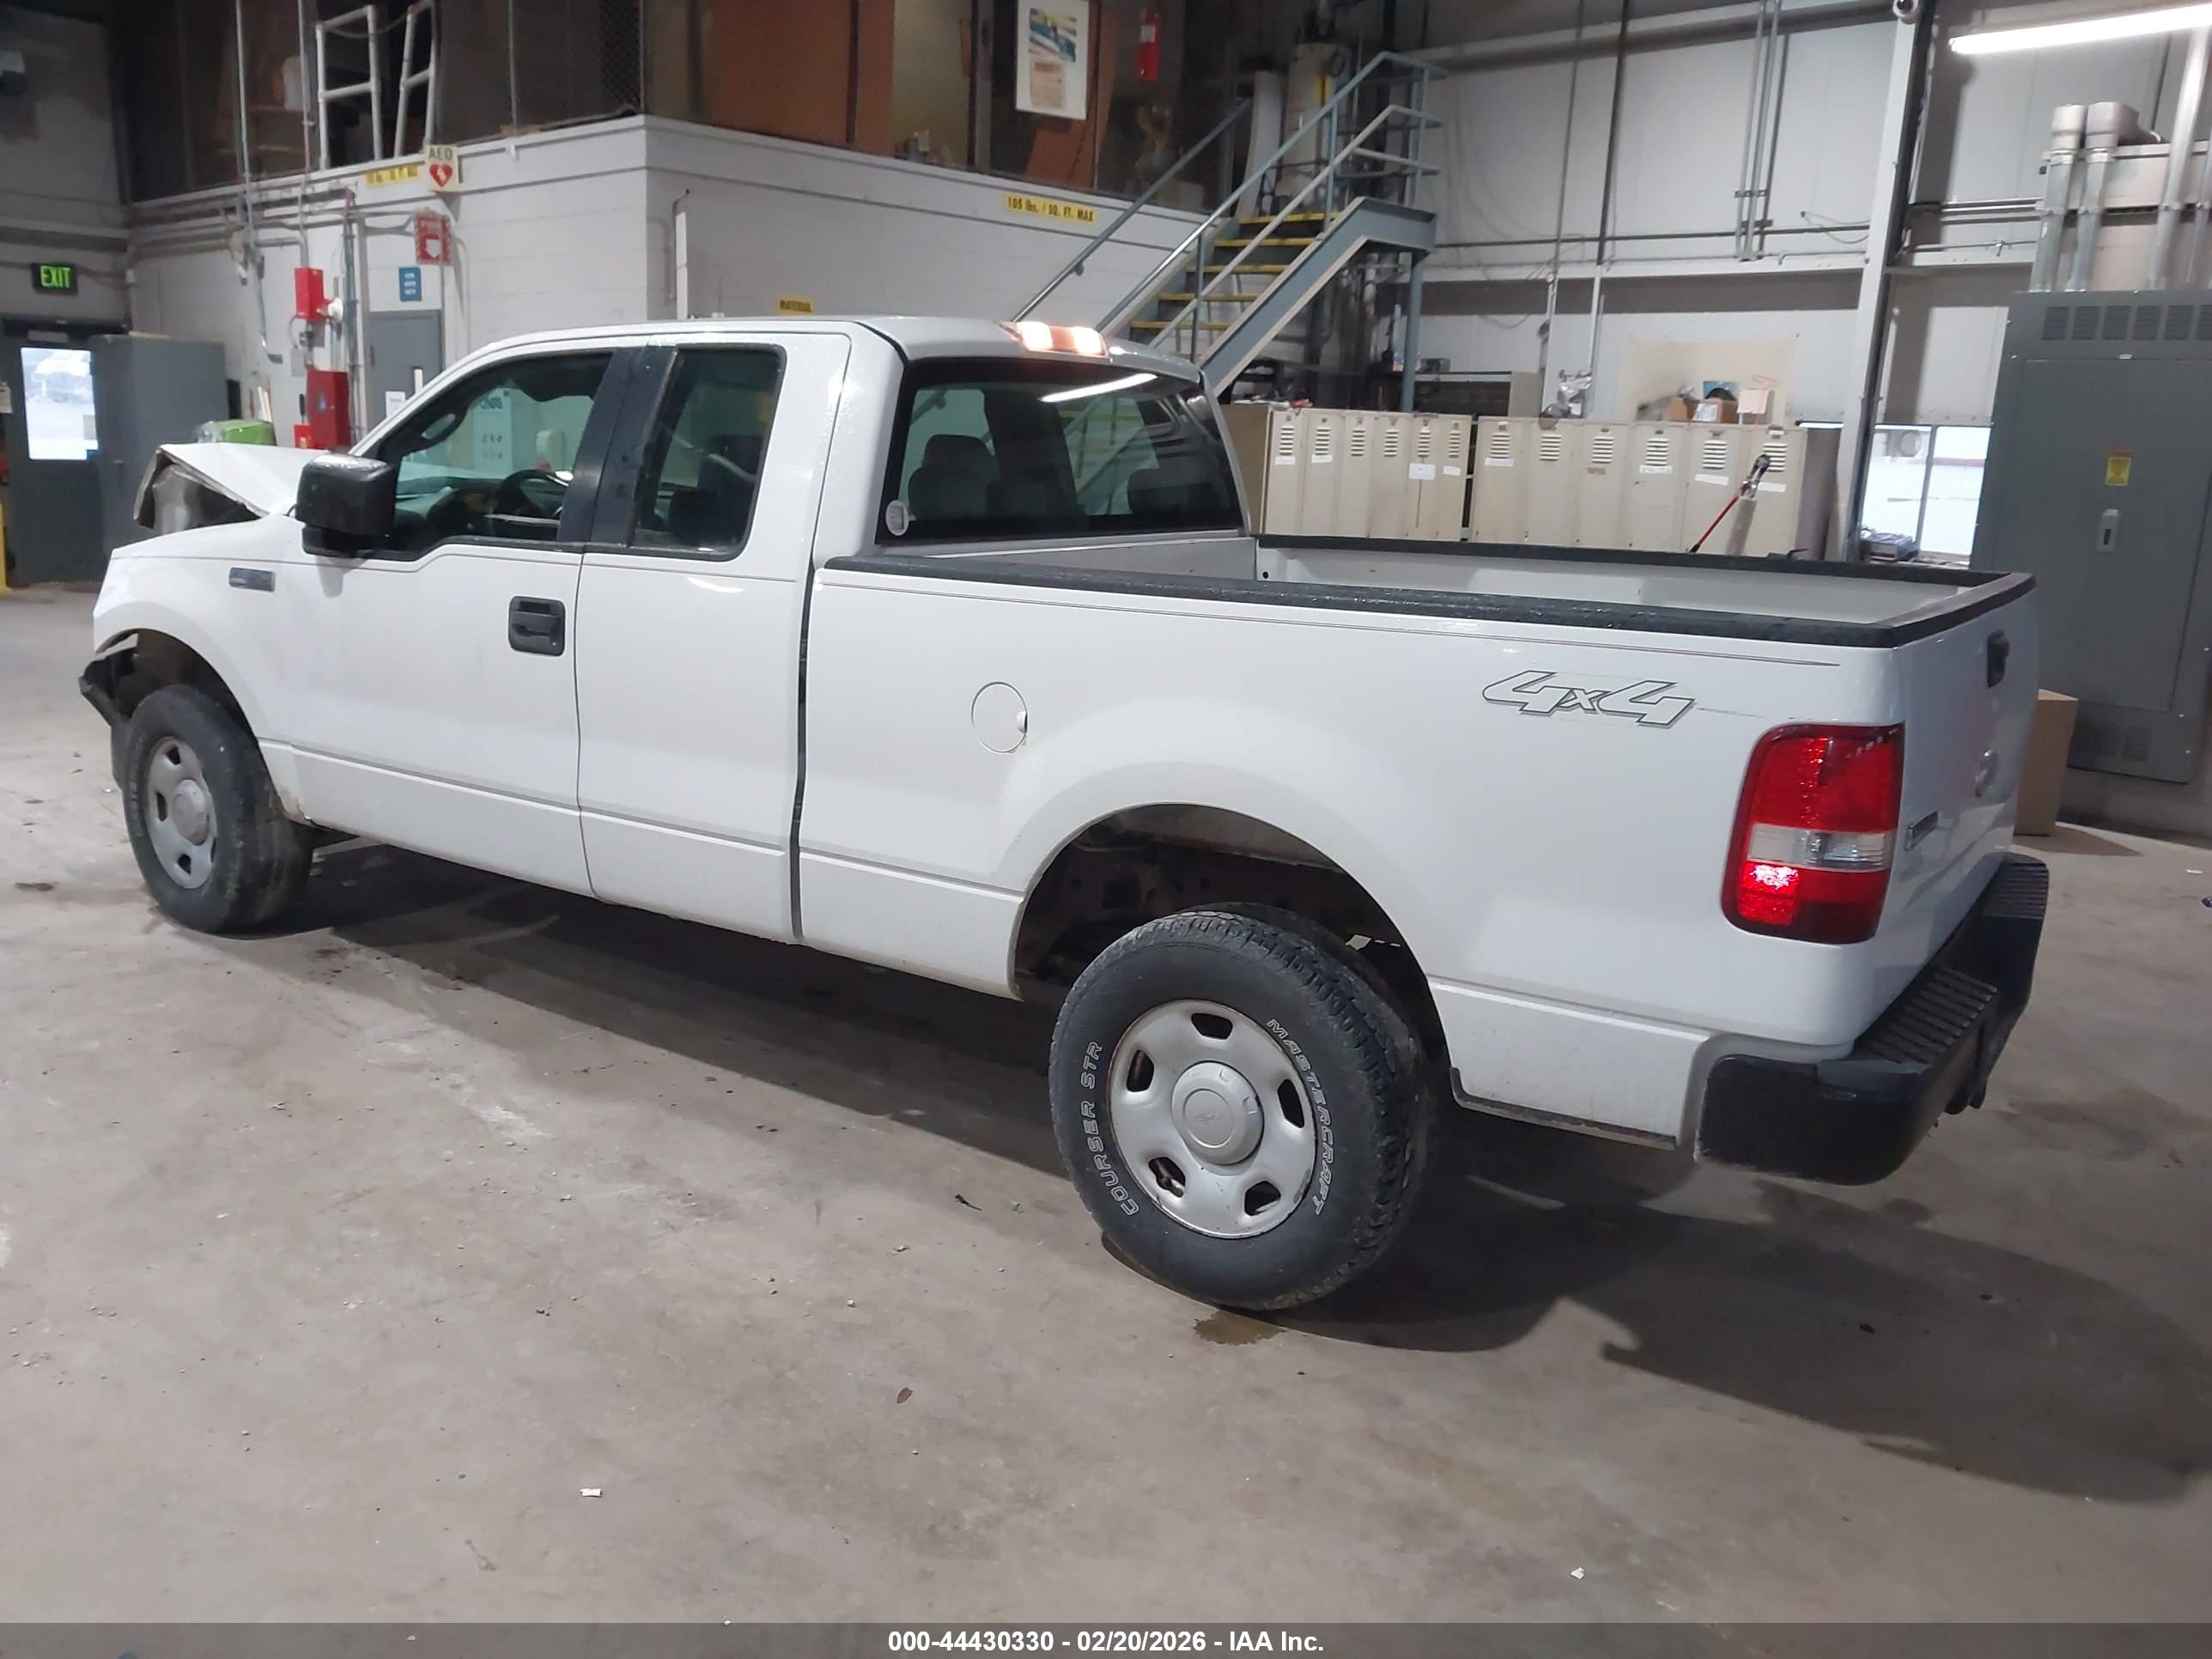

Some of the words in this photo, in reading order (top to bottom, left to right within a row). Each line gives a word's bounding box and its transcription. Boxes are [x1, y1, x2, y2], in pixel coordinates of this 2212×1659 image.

[429, 147, 453, 161] AED
[40, 265, 70, 289] EXIT
[1080, 1041, 1103, 1090] STR
[1266, 1018, 1334, 1216] MASTERCRAFT
[1080, 1100, 1139, 1216] COURSER
